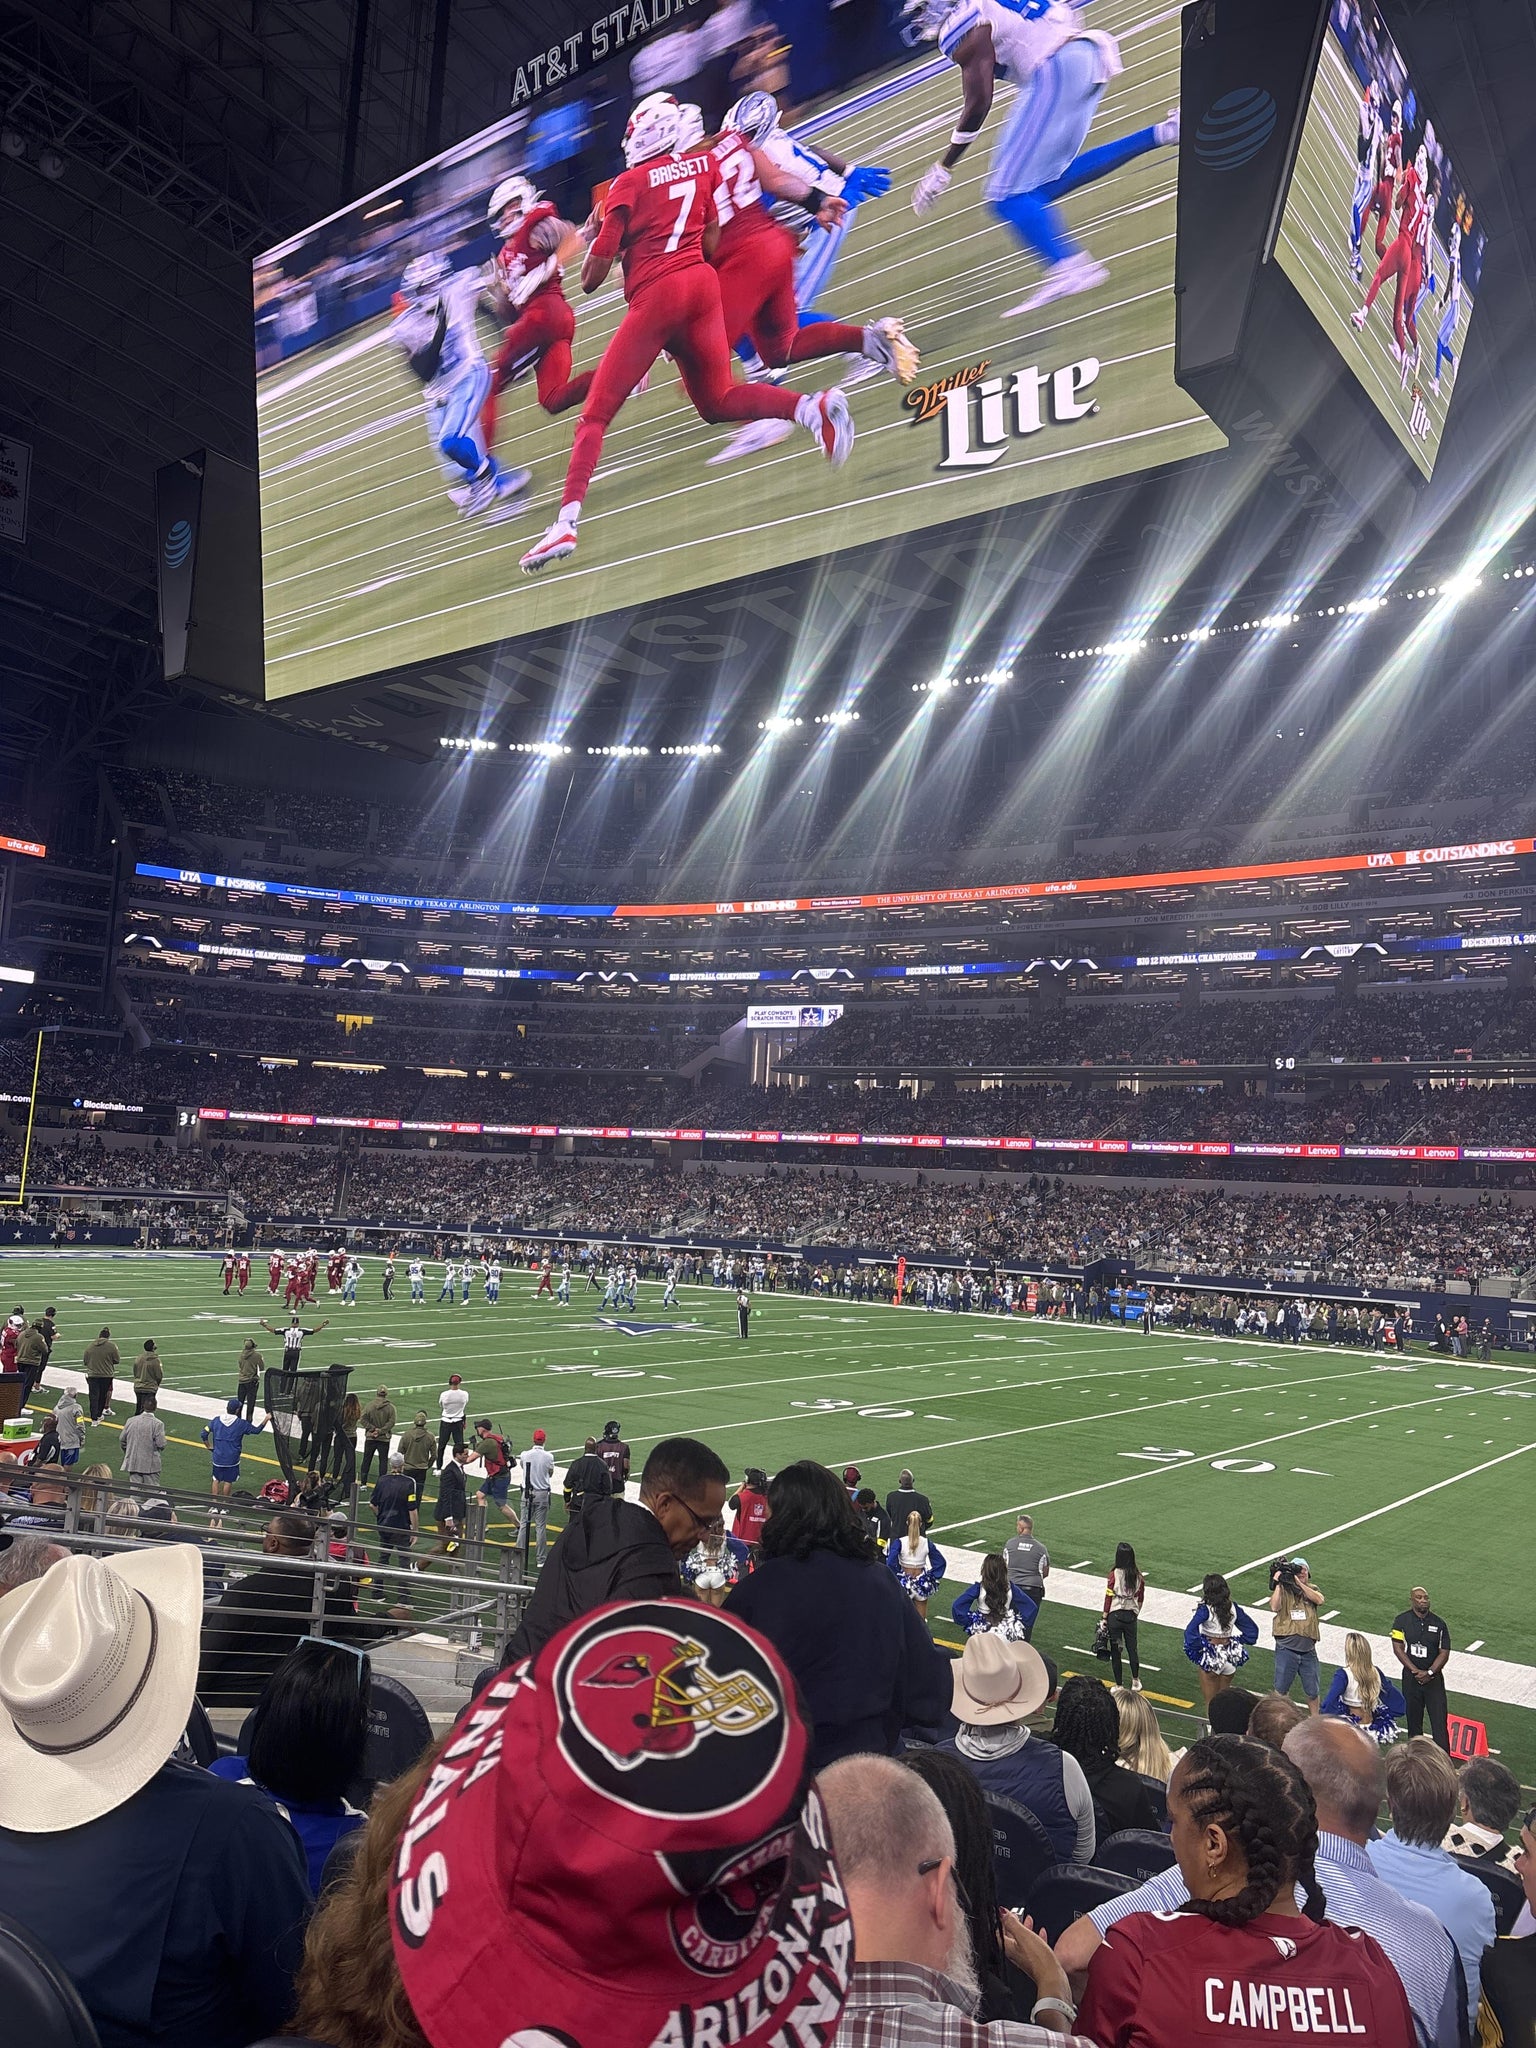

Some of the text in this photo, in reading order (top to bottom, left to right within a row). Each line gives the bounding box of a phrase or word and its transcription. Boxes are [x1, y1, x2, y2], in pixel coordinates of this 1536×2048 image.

[510, 32, 583, 107] AT&T
[650, 155, 710, 188] BRISSETT
[664, 179, 696, 253] 7
[907, 359, 992, 418] Miller
[938, 357, 1101, 466] Lite
[385, 536, 1078, 711] WINSTAR
[7, 840, 40, 853] uta.edu
[1406, 841, 1516, 864] BE OUTSTANDING
[1367, 853, 1394, 866] UTA
[180, 871, 201, 884] UTA
[215, 876, 266, 891] BE INSPIRING
[1045, 883, 1077, 892] uta.edu
[893, 895, 936, 903] UNIVERSITY
[986, 887, 1030, 897] ARLINGTON
[1478, 890, 1495, 898] DON
[1499, 887, 1534, 896] PERKINS
[370, 895, 413, 905] UNIVERSITY
[459, 902, 500, 911] ARLINGTON
[716, 903, 734, 914] UTA
[1312, 903, 1328, 911] BOB
[1331, 901, 1349, 909] LILLY
[512, 905, 540, 913] uta.edu
[1144, 915, 1158, 923] DON
[1160, 912, 1194, 921] MEREDITH
[1461, 935, 1512, 948] DECEMBER
[1513, 935, 1523, 946] 6,
[220, 947, 254, 958] FOOTBALL
[1136, 951, 1257, 966] BIG 12 FOOTBALL CHAMPIONSHIP
[83, 1100, 144, 1113] Blockchain.com
[201, 1109, 224, 1118] Lenovo
[288, 1115, 311, 1123] Lenovo
[374, 1120, 397, 1128] Lenovo
[535, 1126, 555, 1134] Lenovo
[607, 1128, 627, 1136] Lenovo
[680, 1131, 701, 1139] Lenovo
[756, 1132, 777, 1140] Lenovo
[835, 1135, 857, 1143] Lenovo
[917, 1137, 940, 1145] Lenovo
[1006, 1139, 1030, 1147] Lenovo
[1100, 1141, 1125, 1150] Lenovo
[1200, 1144, 1228, 1153] Lenovo
[1256, 1146, 1285, 1154] technology
[1308, 1146, 1337, 1155] Lenovo
[1344, 1147, 1367, 1155] Smarter
[1368, 1148, 1400, 1156] technology
[1424, 1148, 1455, 1157] Lenovo
[1490, 1150, 1524, 1159] technology
[602, 1451, 620, 1459] ESPN
[1450, 1721, 1478, 1756] 10
[1204, 1977, 1367, 2034] CAMPBELL
